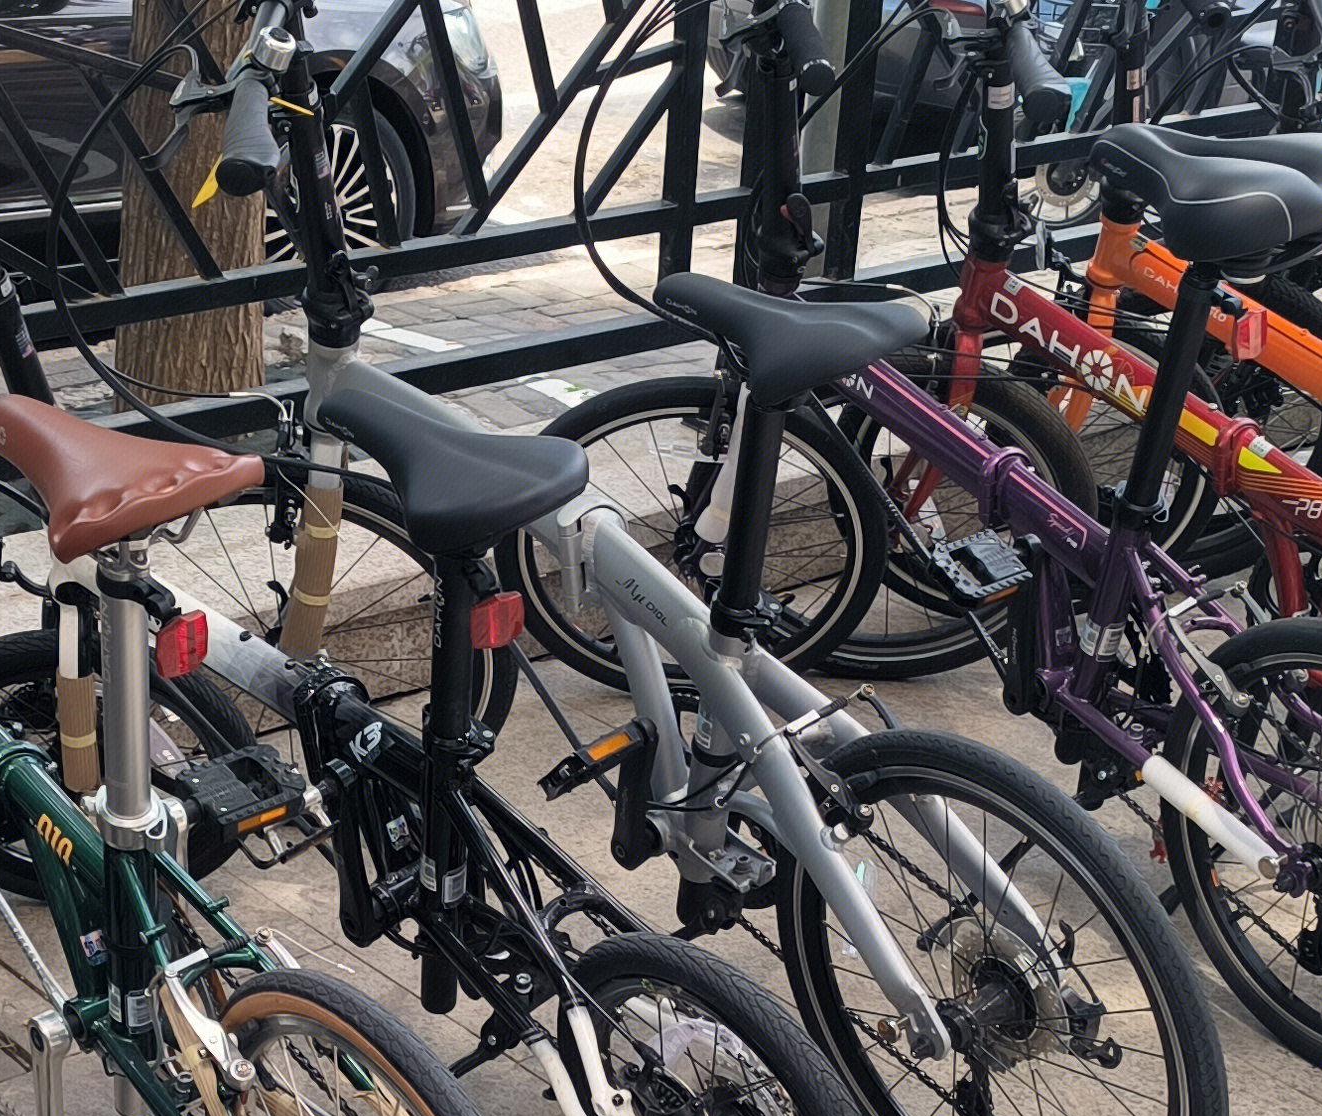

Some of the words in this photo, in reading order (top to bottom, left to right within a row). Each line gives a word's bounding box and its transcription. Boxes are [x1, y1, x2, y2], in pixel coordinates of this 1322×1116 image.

[1143, 266, 1178, 294] DAH
[990, 292, 1149, 412] DAHON
[349, 721, 383, 763] K3
